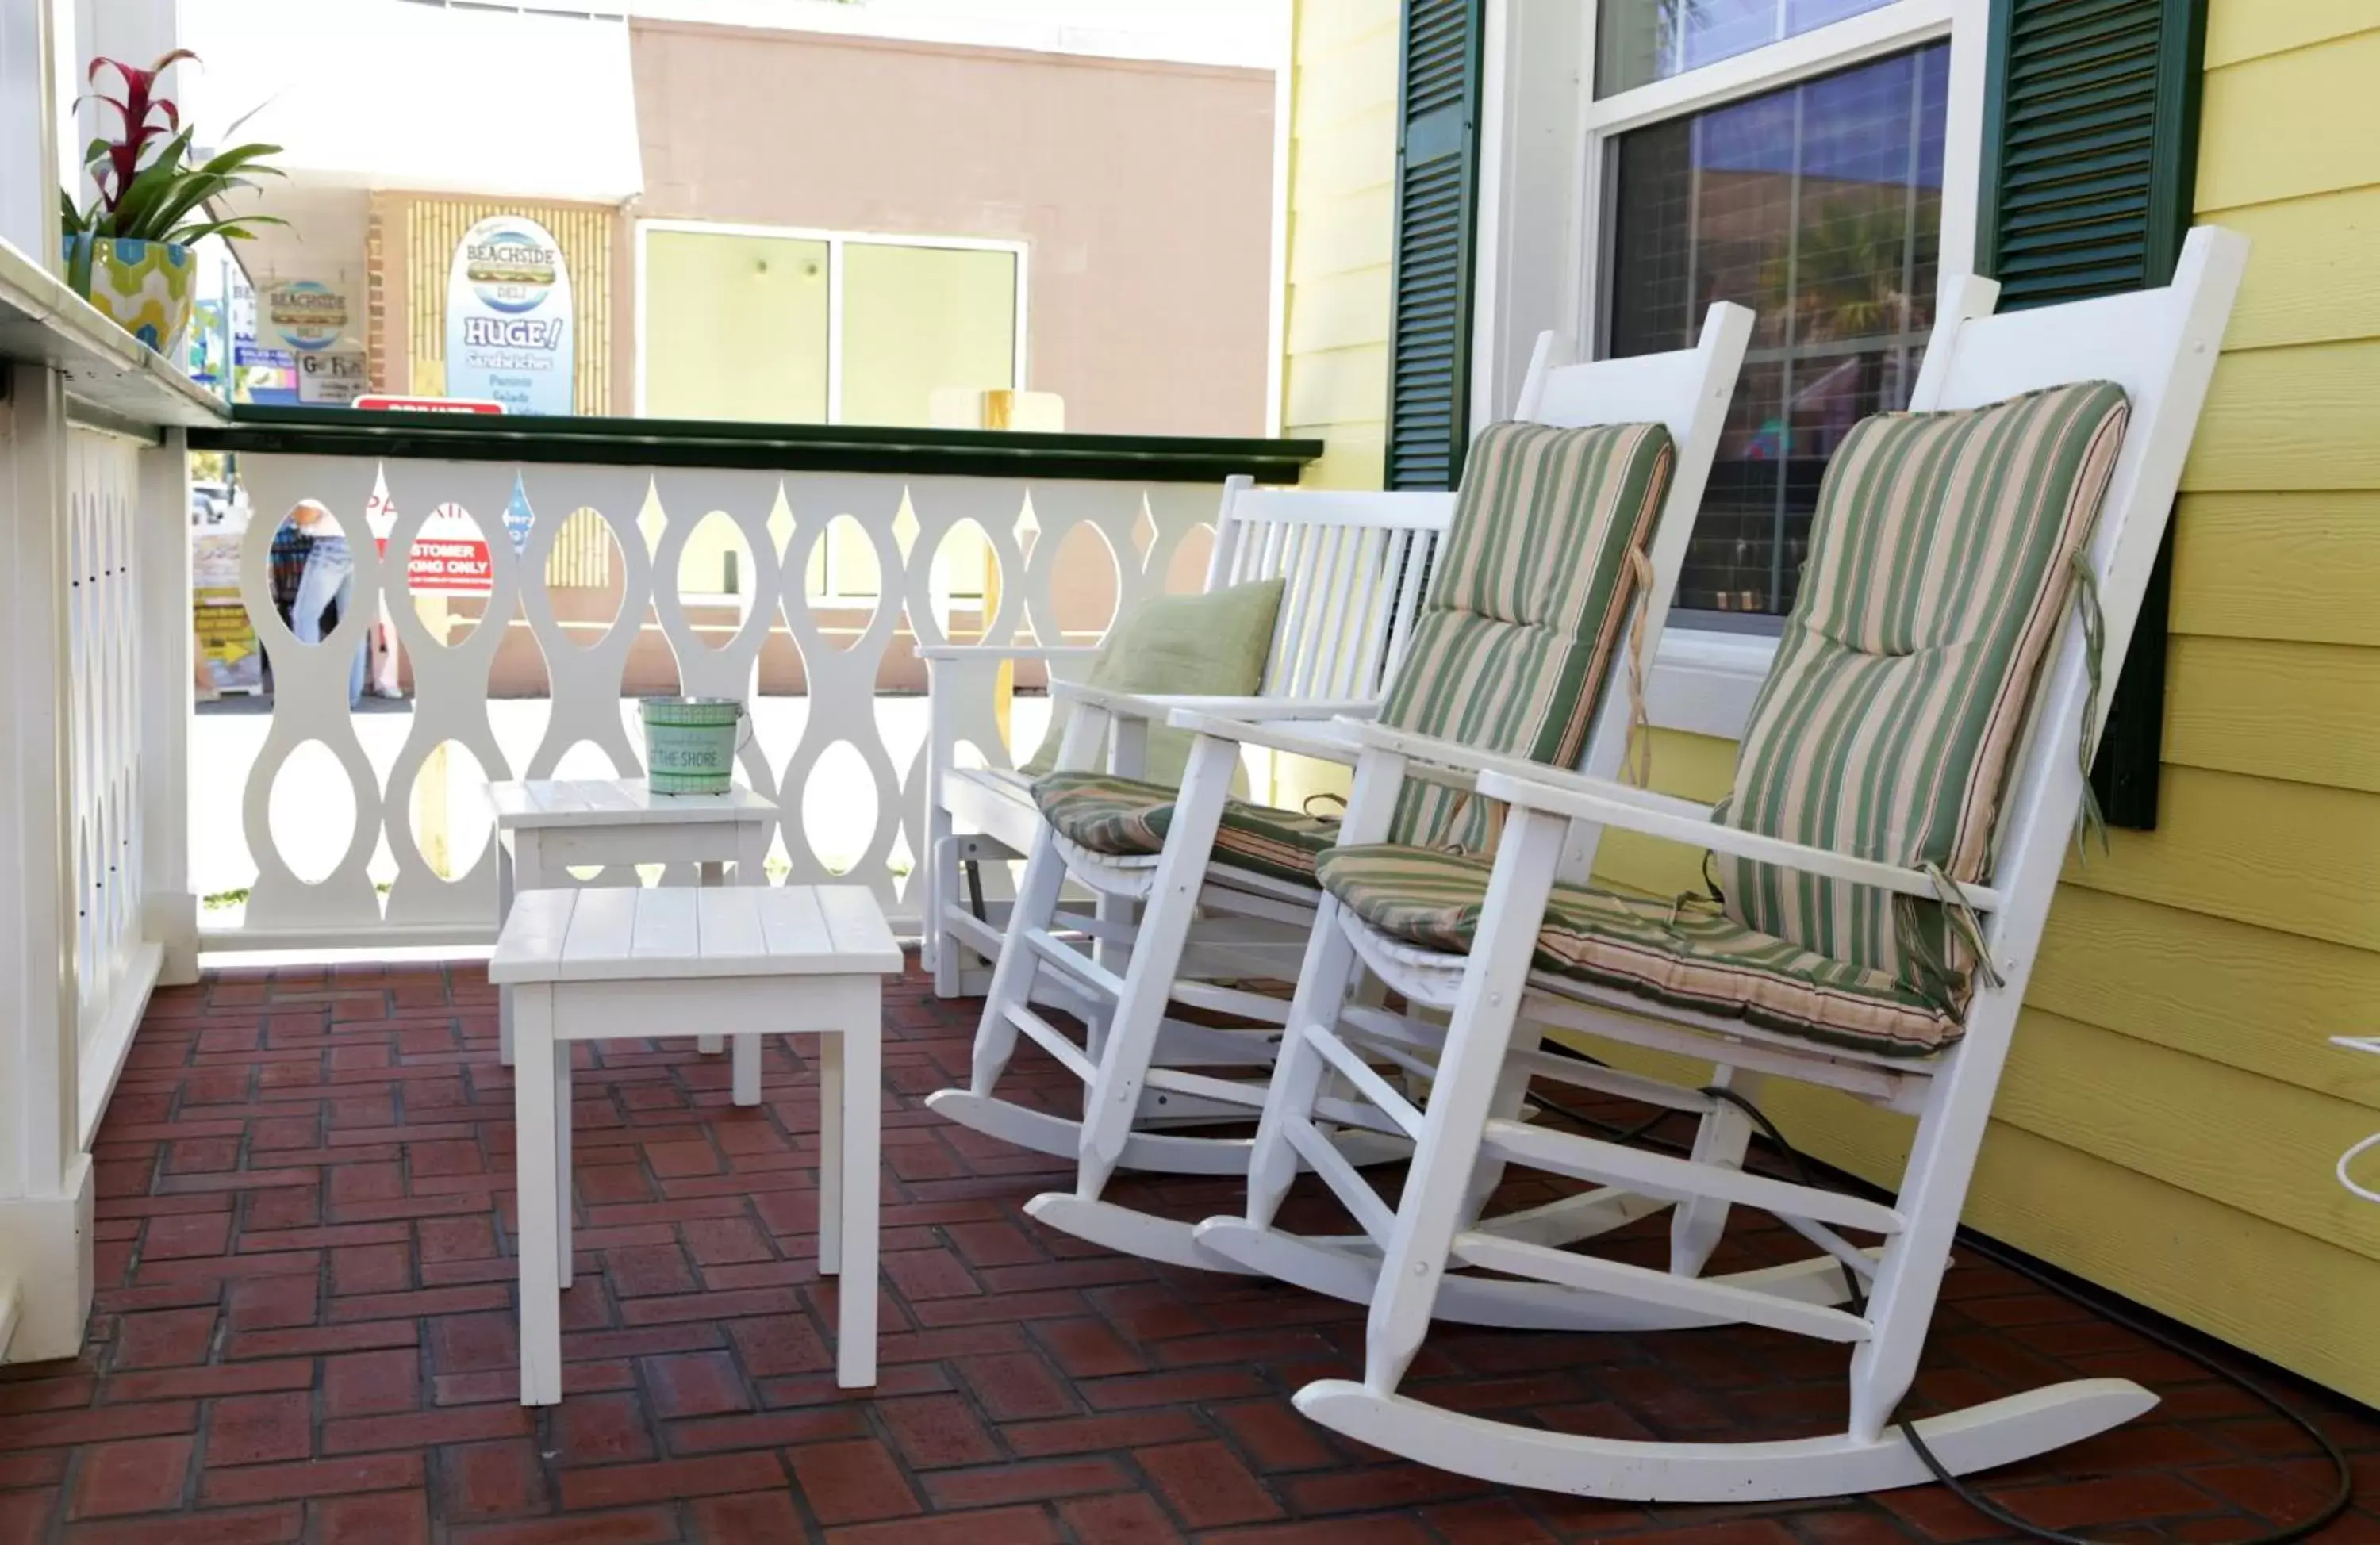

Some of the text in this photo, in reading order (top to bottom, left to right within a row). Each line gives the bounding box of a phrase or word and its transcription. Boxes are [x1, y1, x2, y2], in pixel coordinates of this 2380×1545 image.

[466, 244, 555, 264] BEACHSIDE
[497, 286, 526, 299] DELI
[271, 293, 346, 309] BEACHSIDE
[464, 317, 563, 351] HUGE!
[466, 350, 553, 370] Sandwiches
[410, 544, 475, 557] STOMER
[408, 558, 488, 573] KING ONLY
[680, 750, 718, 767] SHORE
